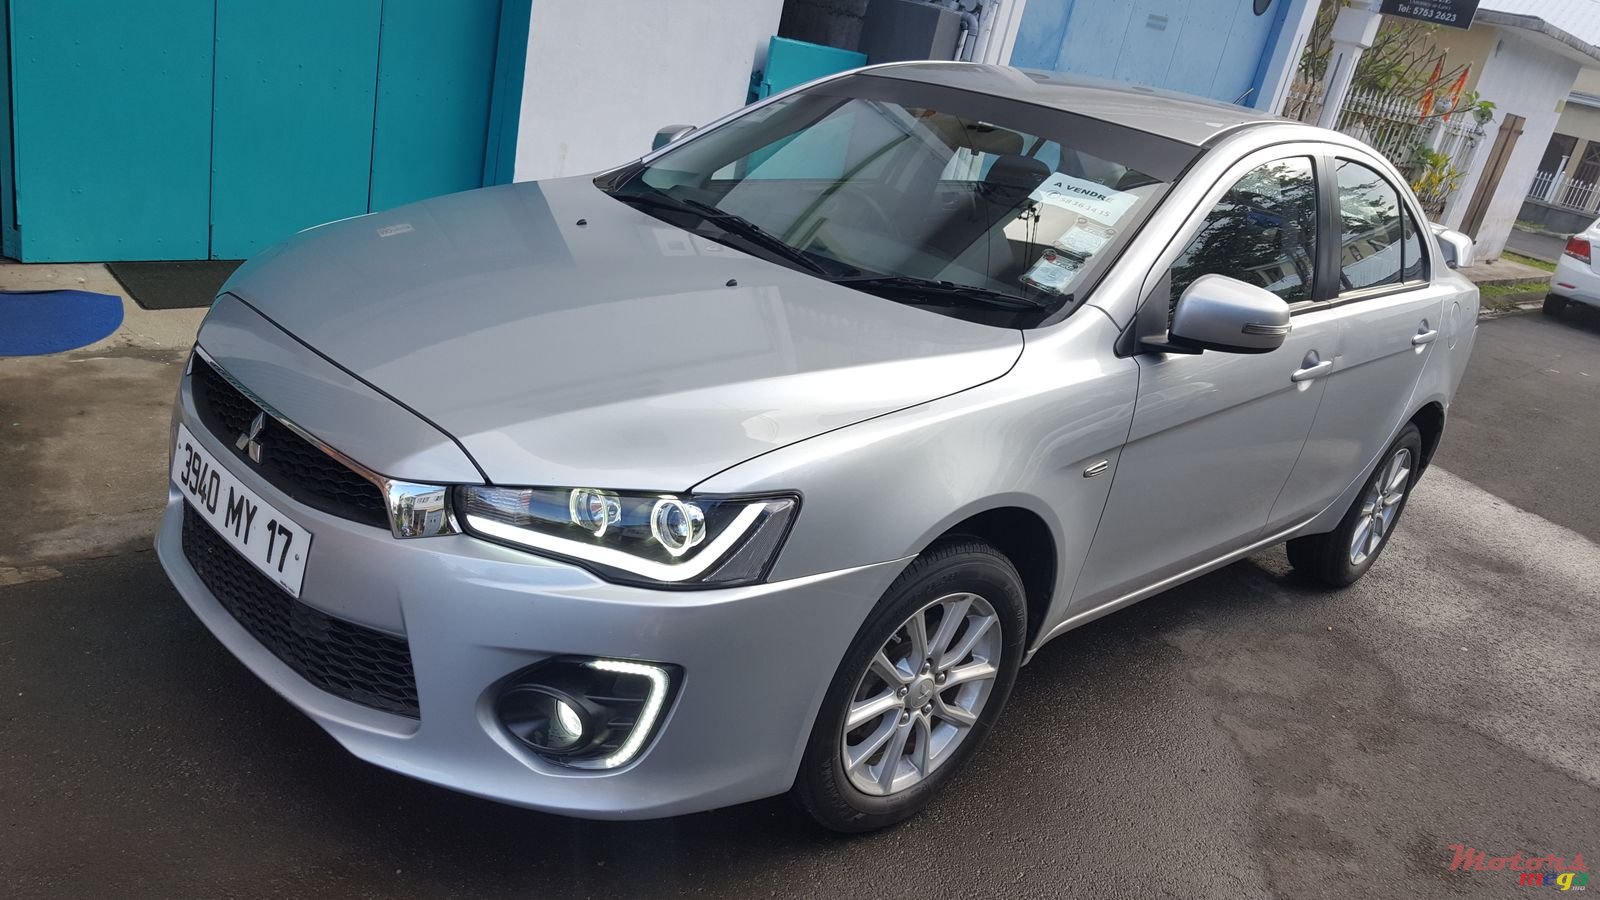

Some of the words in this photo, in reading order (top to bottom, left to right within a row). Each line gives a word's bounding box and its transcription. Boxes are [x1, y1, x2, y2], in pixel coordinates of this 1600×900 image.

[1435, 11, 1457, 22] 2623
[1067, 185, 1113, 202] VENDRE
[181, 442, 221, 515] 3940
[225, 485, 258, 545] MY
[267, 519, 293, 573] 17
